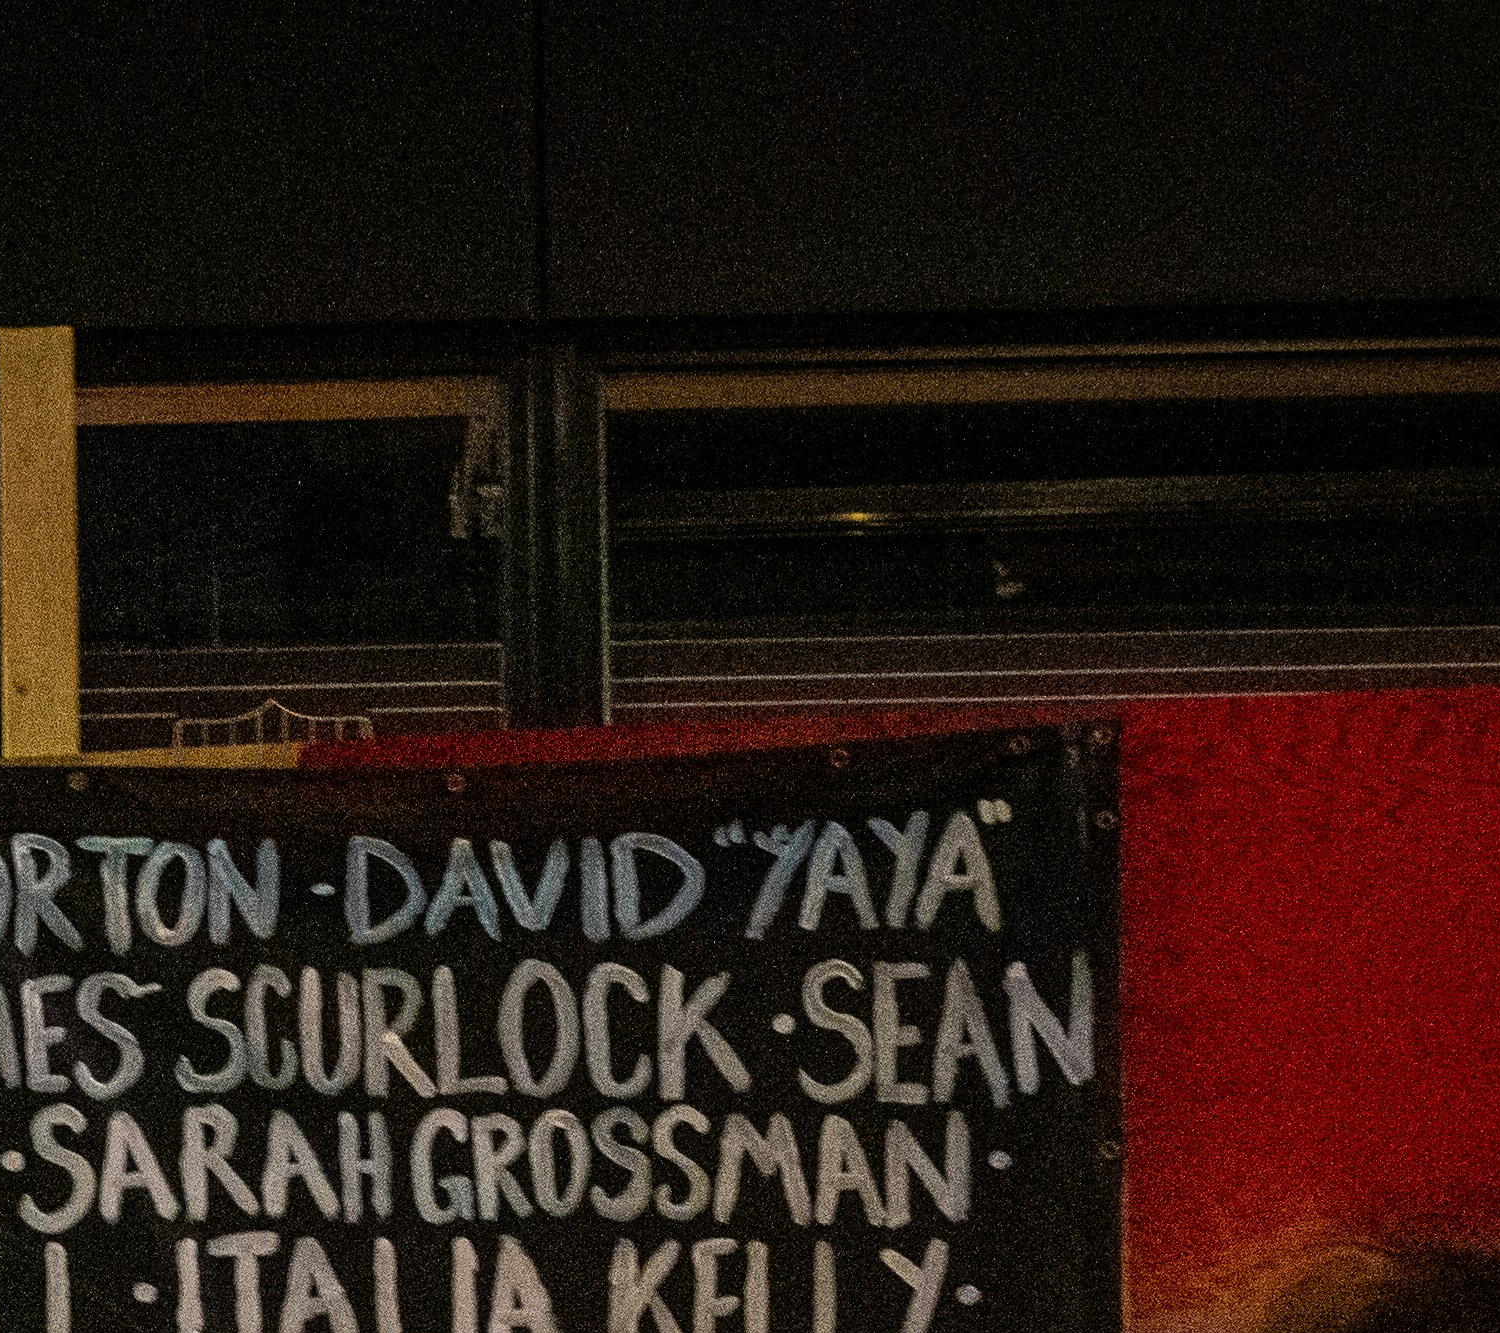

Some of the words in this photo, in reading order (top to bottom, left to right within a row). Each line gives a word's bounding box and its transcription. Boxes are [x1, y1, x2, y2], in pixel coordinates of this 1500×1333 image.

[343, 832, 706, 943] DAVID
[173, 959, 753, 1101] SCURLOCK
[798, 950, 1095, 1107] SEAN
[17, 1102, 392, 1231] SARAH
[411, 1106, 972, 1229] GROSSMAN
